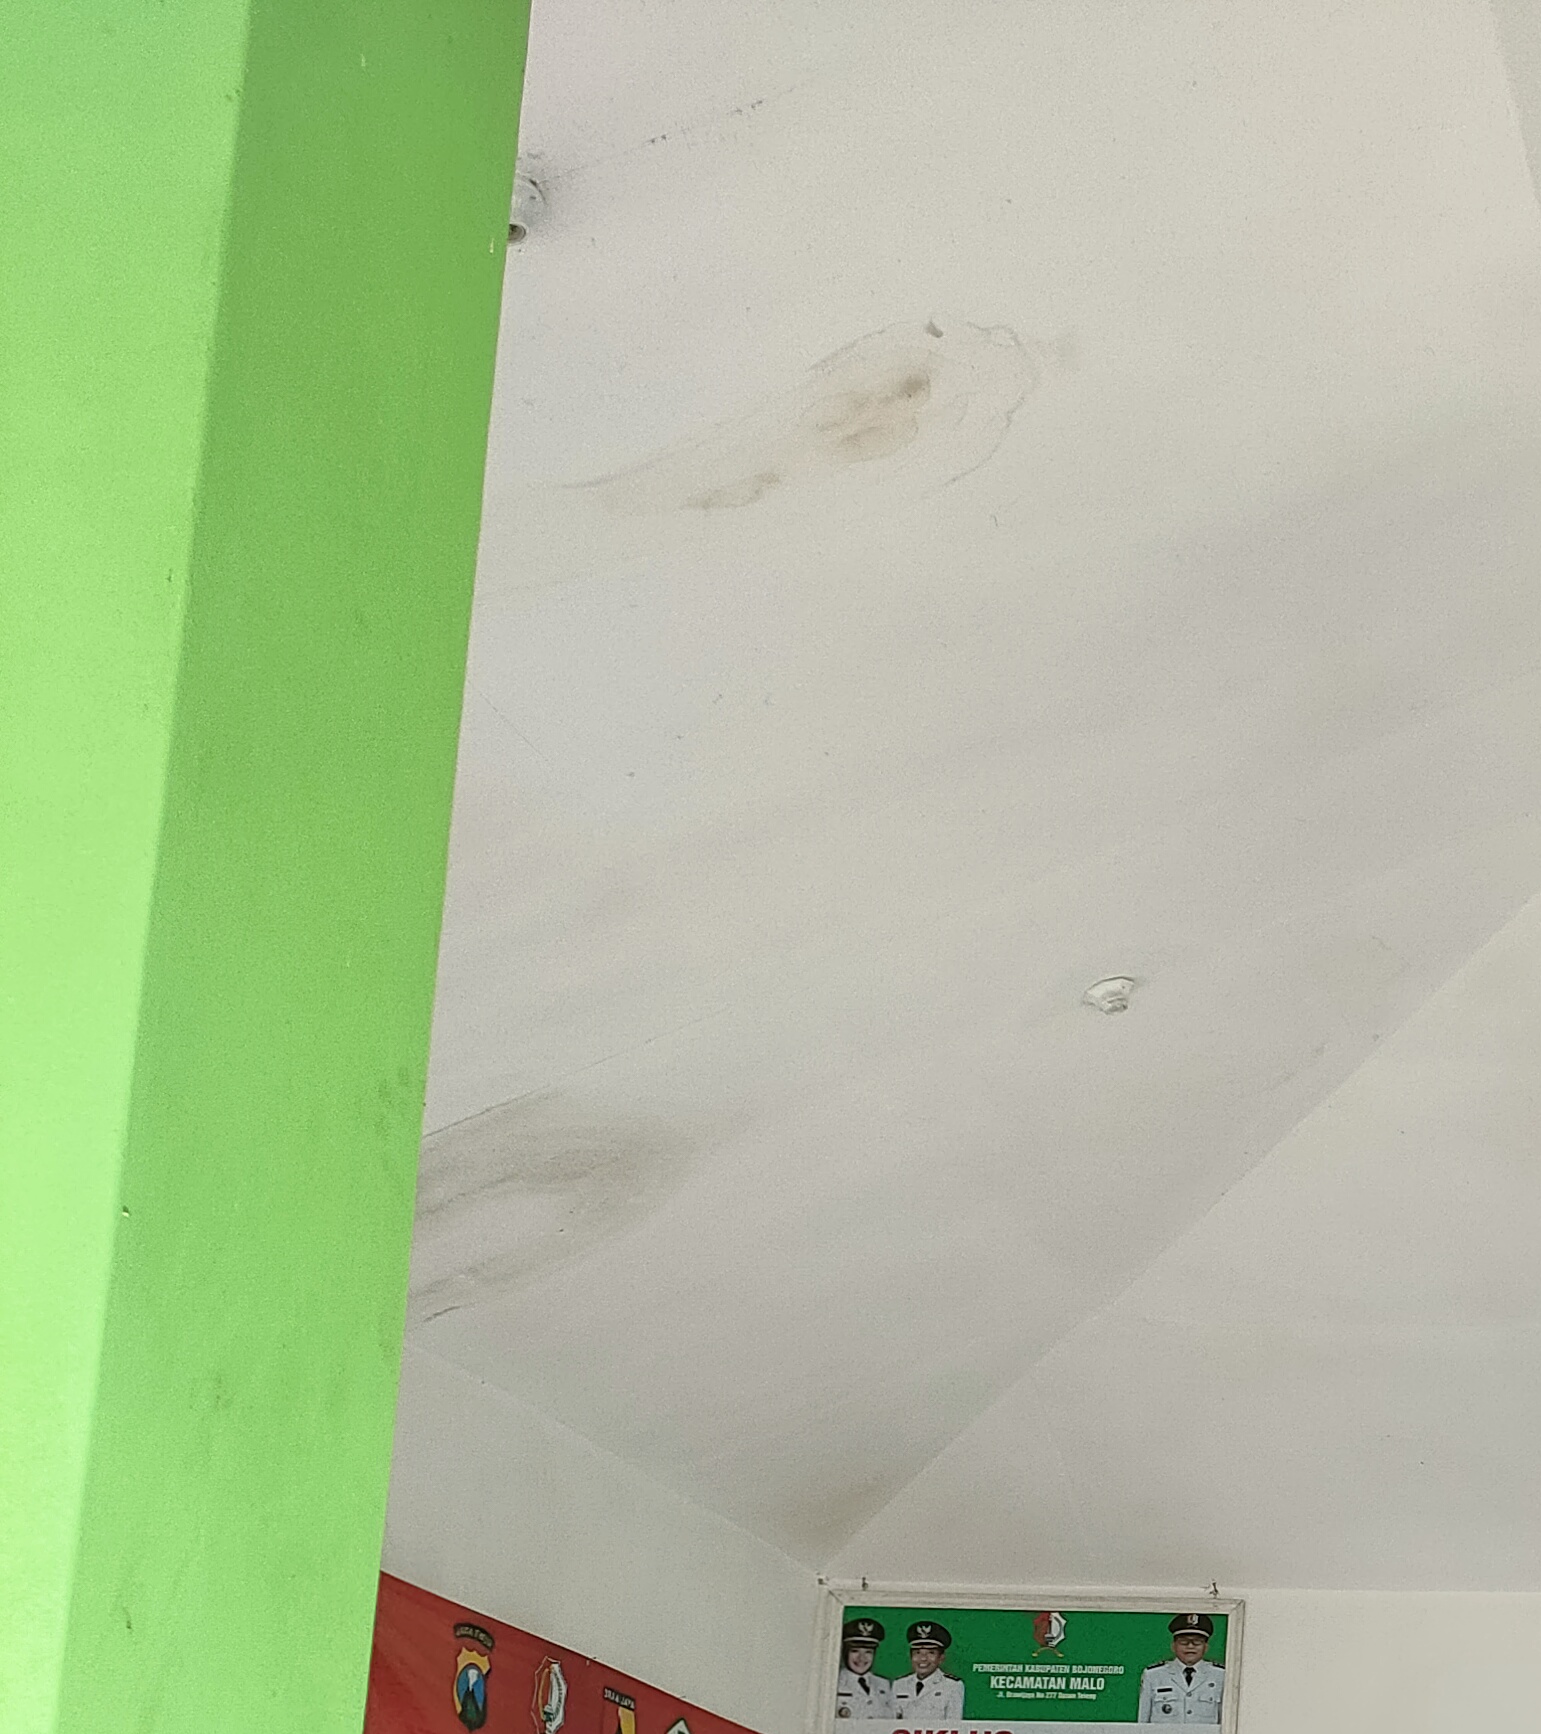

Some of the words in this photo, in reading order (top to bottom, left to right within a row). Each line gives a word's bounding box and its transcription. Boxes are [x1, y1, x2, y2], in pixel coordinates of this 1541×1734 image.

[1025, 1664, 1069, 1673] KABUPATEN
[990, 1676, 1065, 1689] KECAMATAN
[1070, 1677, 1104, 1690] MALO
